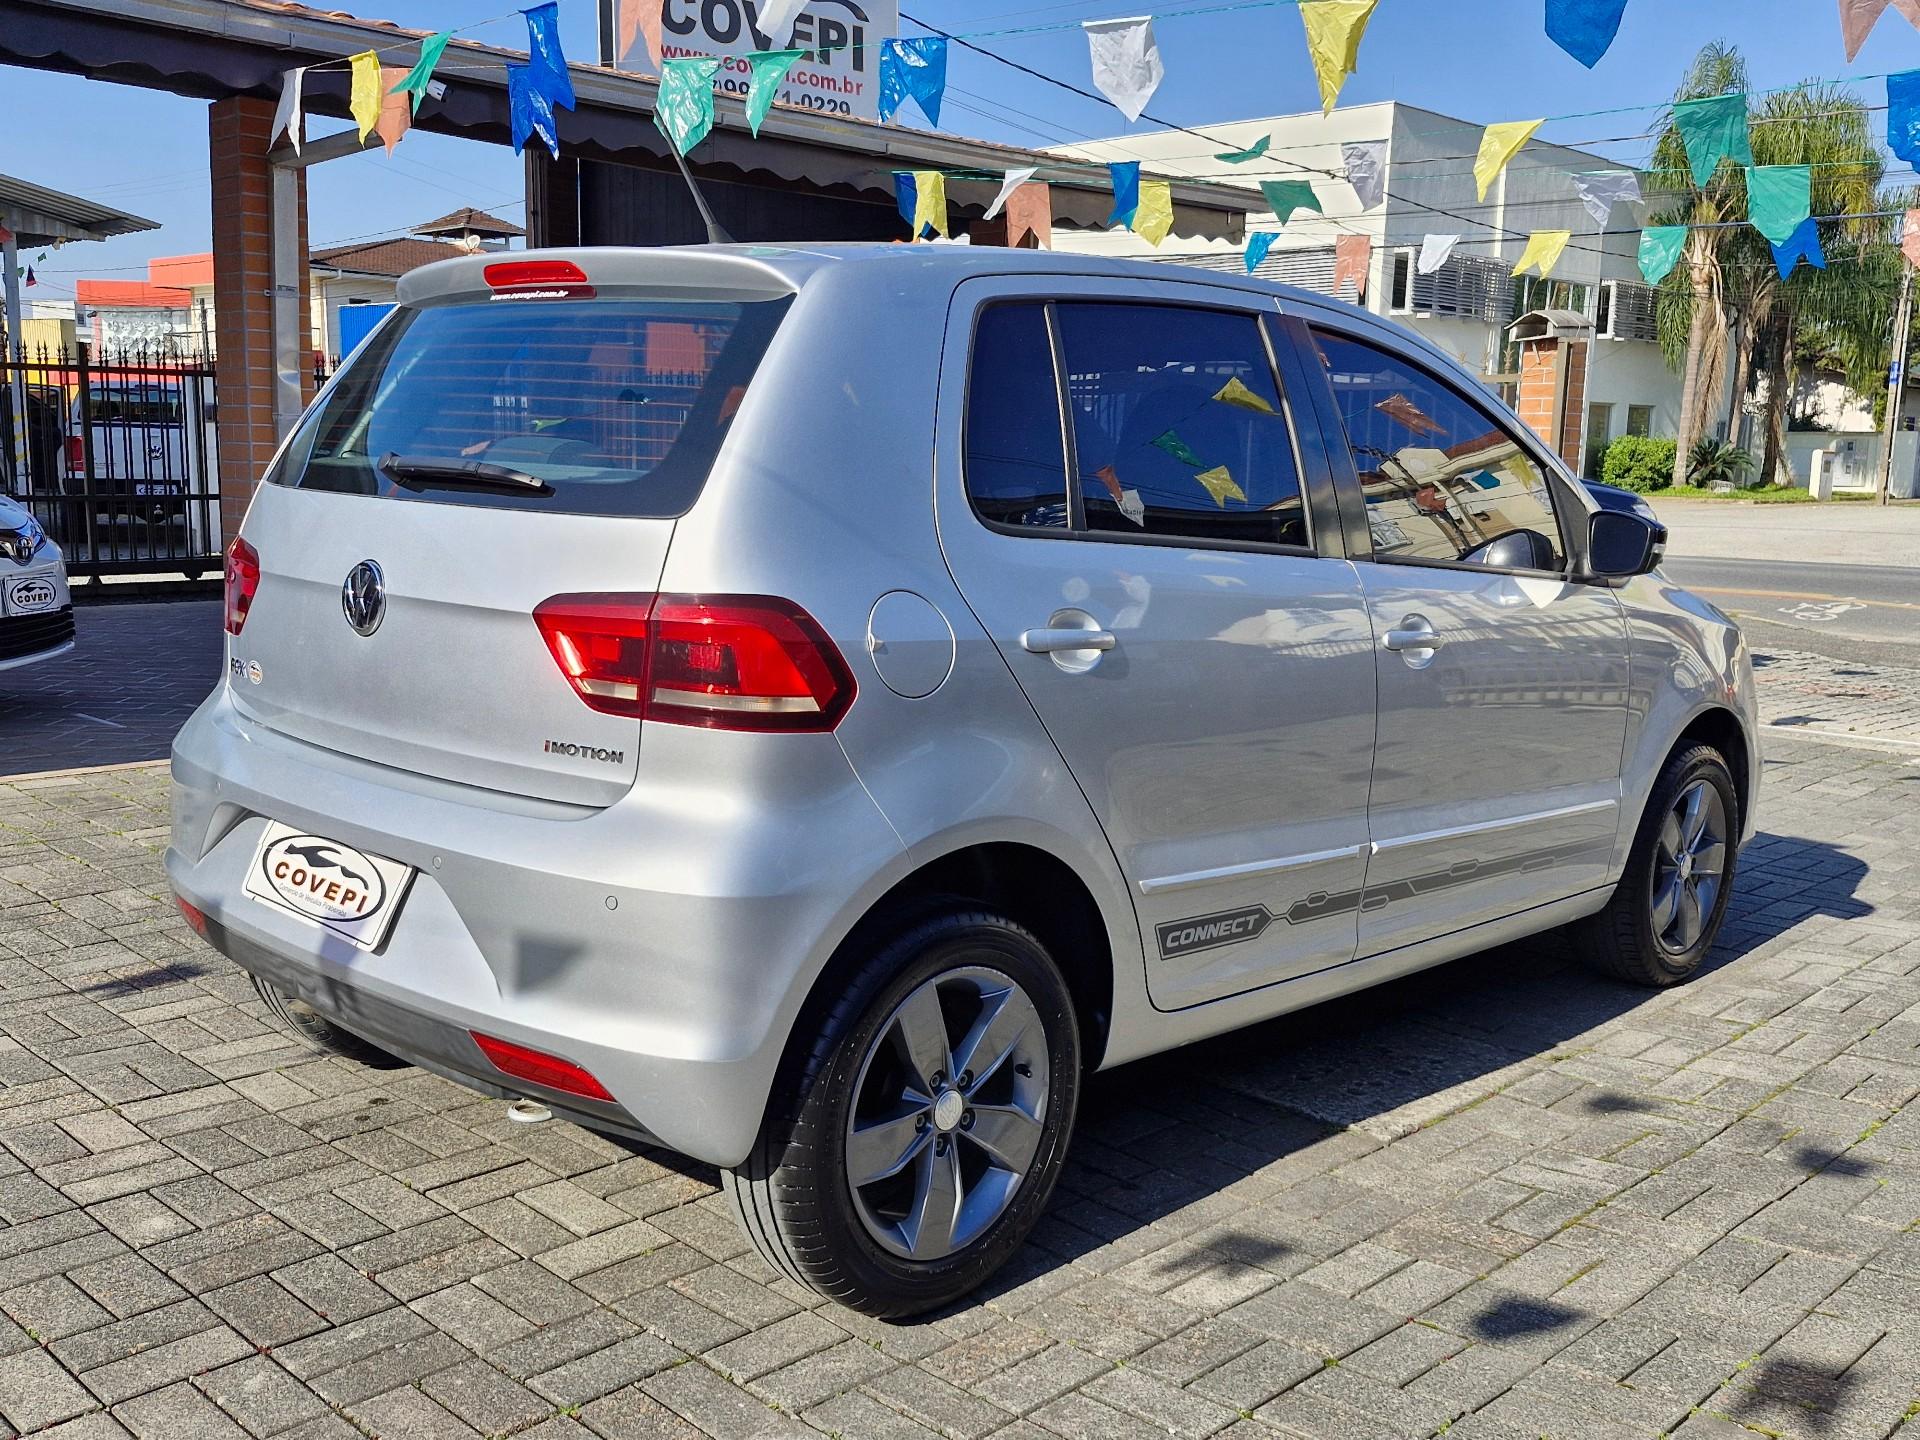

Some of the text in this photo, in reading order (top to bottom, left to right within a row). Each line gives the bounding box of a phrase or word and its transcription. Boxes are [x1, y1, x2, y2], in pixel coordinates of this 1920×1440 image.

[660, 0, 864, 73] COVEPI
[17, 592, 52, 604] COVEPI
[275, 861, 369, 914] COVEPI
[1166, 914, 1260, 948] CONNECT
